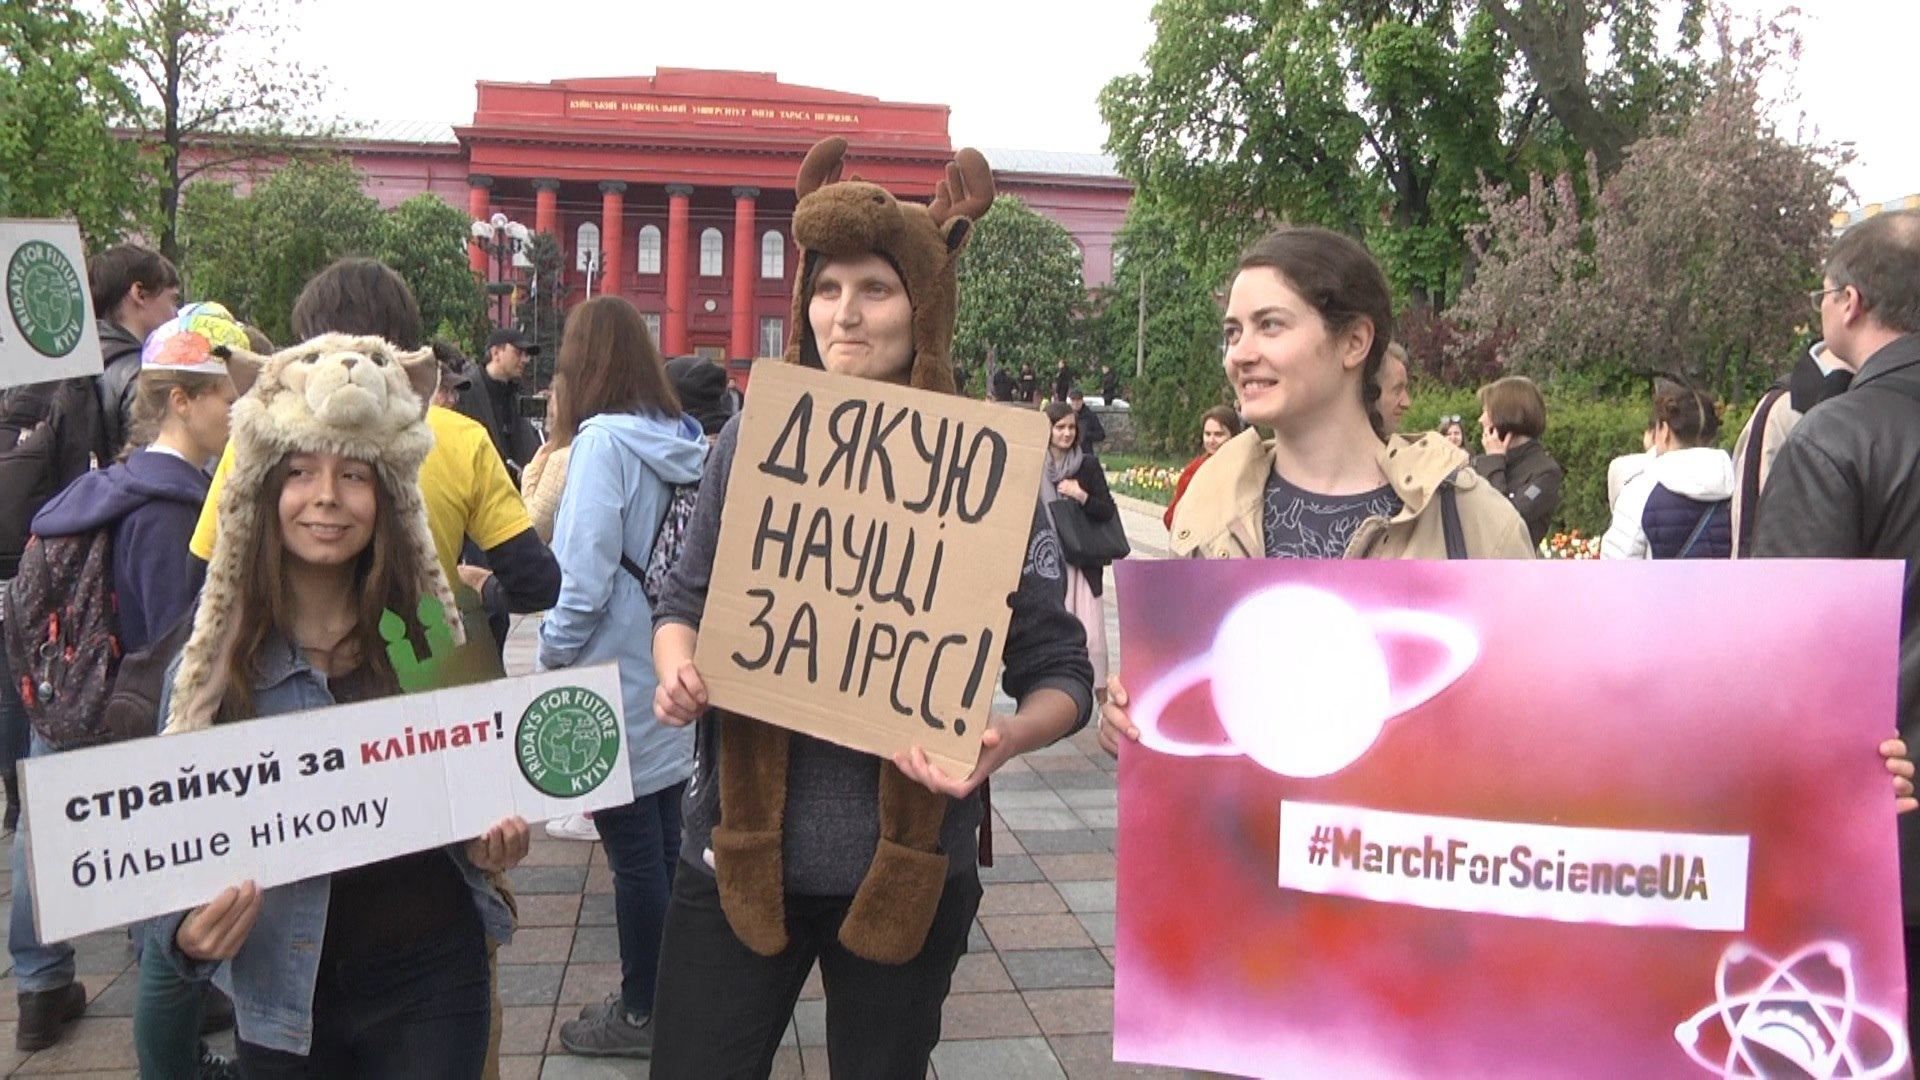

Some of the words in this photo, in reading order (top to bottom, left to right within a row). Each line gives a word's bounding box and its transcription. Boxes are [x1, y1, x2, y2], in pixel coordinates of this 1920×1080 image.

[21, 244, 44, 266] FOR
[46, 246, 80, 300] FUTURE
[10, 262, 36, 337] FRIDAYS
[53, 319, 80, 352] KYIV
[758, 391, 1008, 523] ДЯКУЮ
[731, 589, 818, 683] ЗА
[64, 750, 281, 822] страйкуй
[298, 746, 346, 777] за
[360, 711, 504, 767] клімат!
[522, 711, 547, 780] FRIDAYS
[540, 690, 571, 714] FOR
[574, 691, 617, 739] FUTURE
[571, 757, 609, 792] KYIV
[71, 831, 231, 888] більше
[250, 796, 390, 849] нікому
[1307, 825, 1709, 901] #MarchForScienceUA
